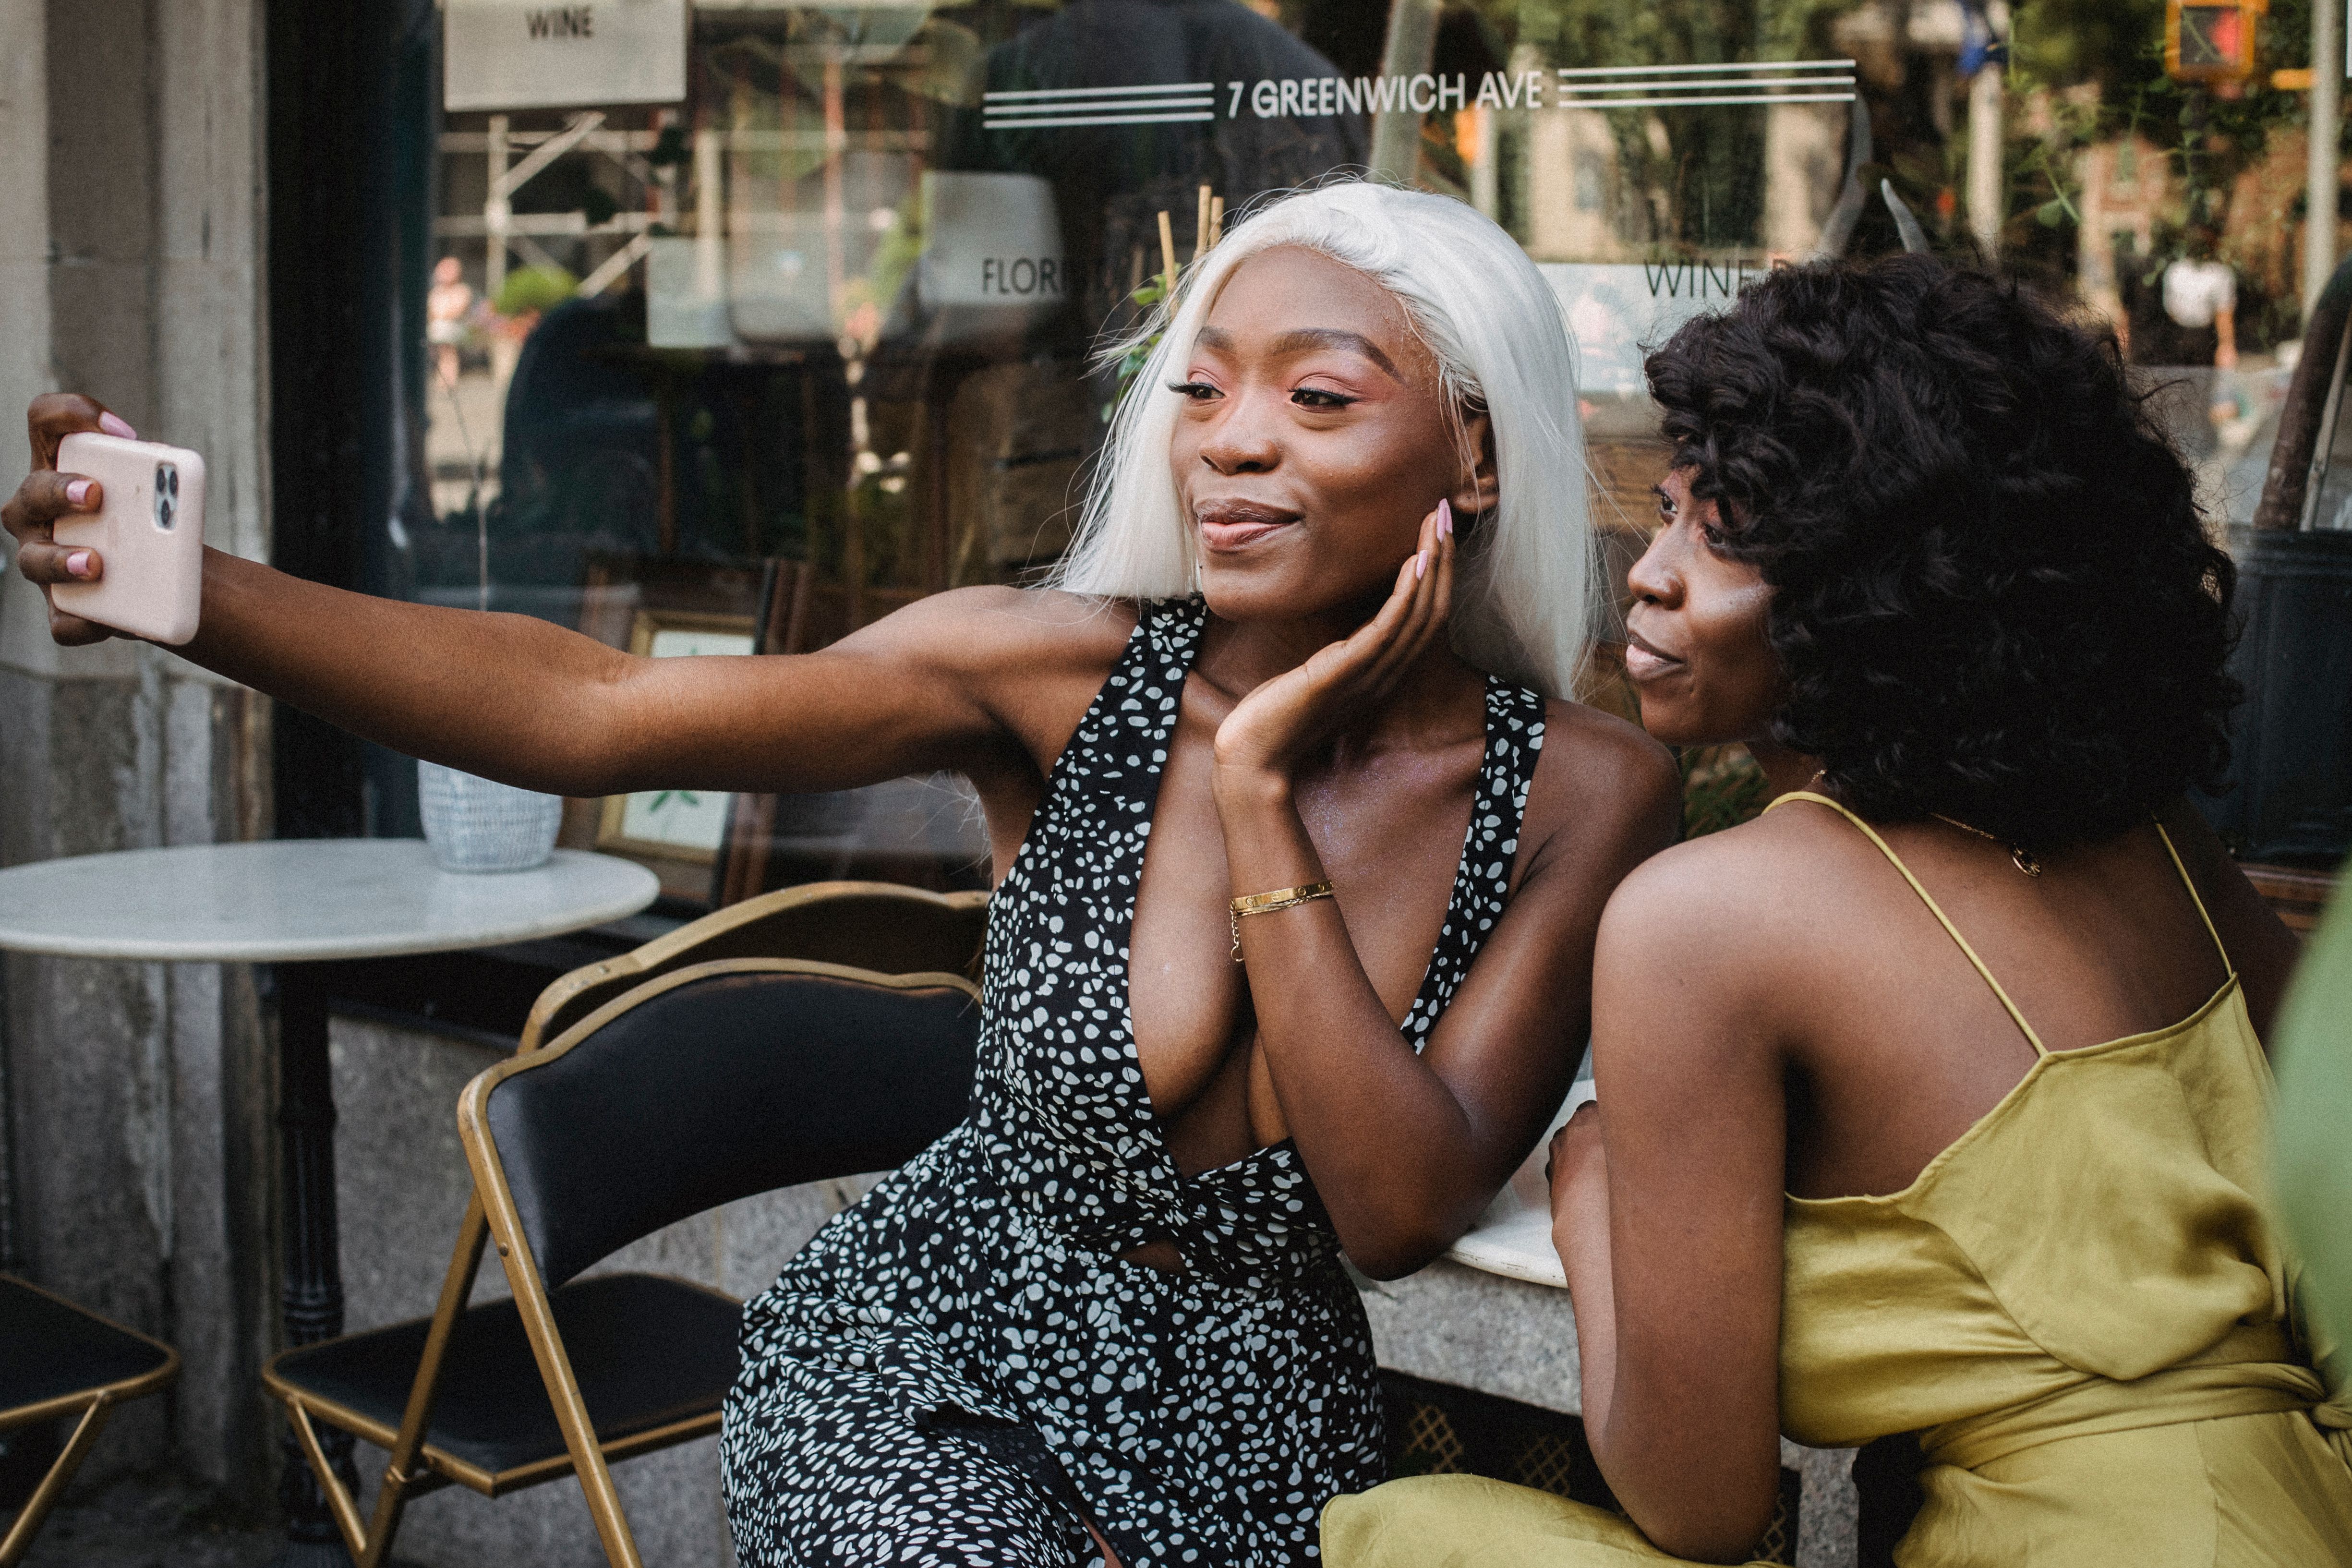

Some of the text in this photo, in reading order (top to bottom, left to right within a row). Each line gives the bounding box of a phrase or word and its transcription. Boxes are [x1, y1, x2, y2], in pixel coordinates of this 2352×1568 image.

[525, 6, 594, 38] WINE
[1228, 71, 1543, 119] 7 GREENWICH AVE
